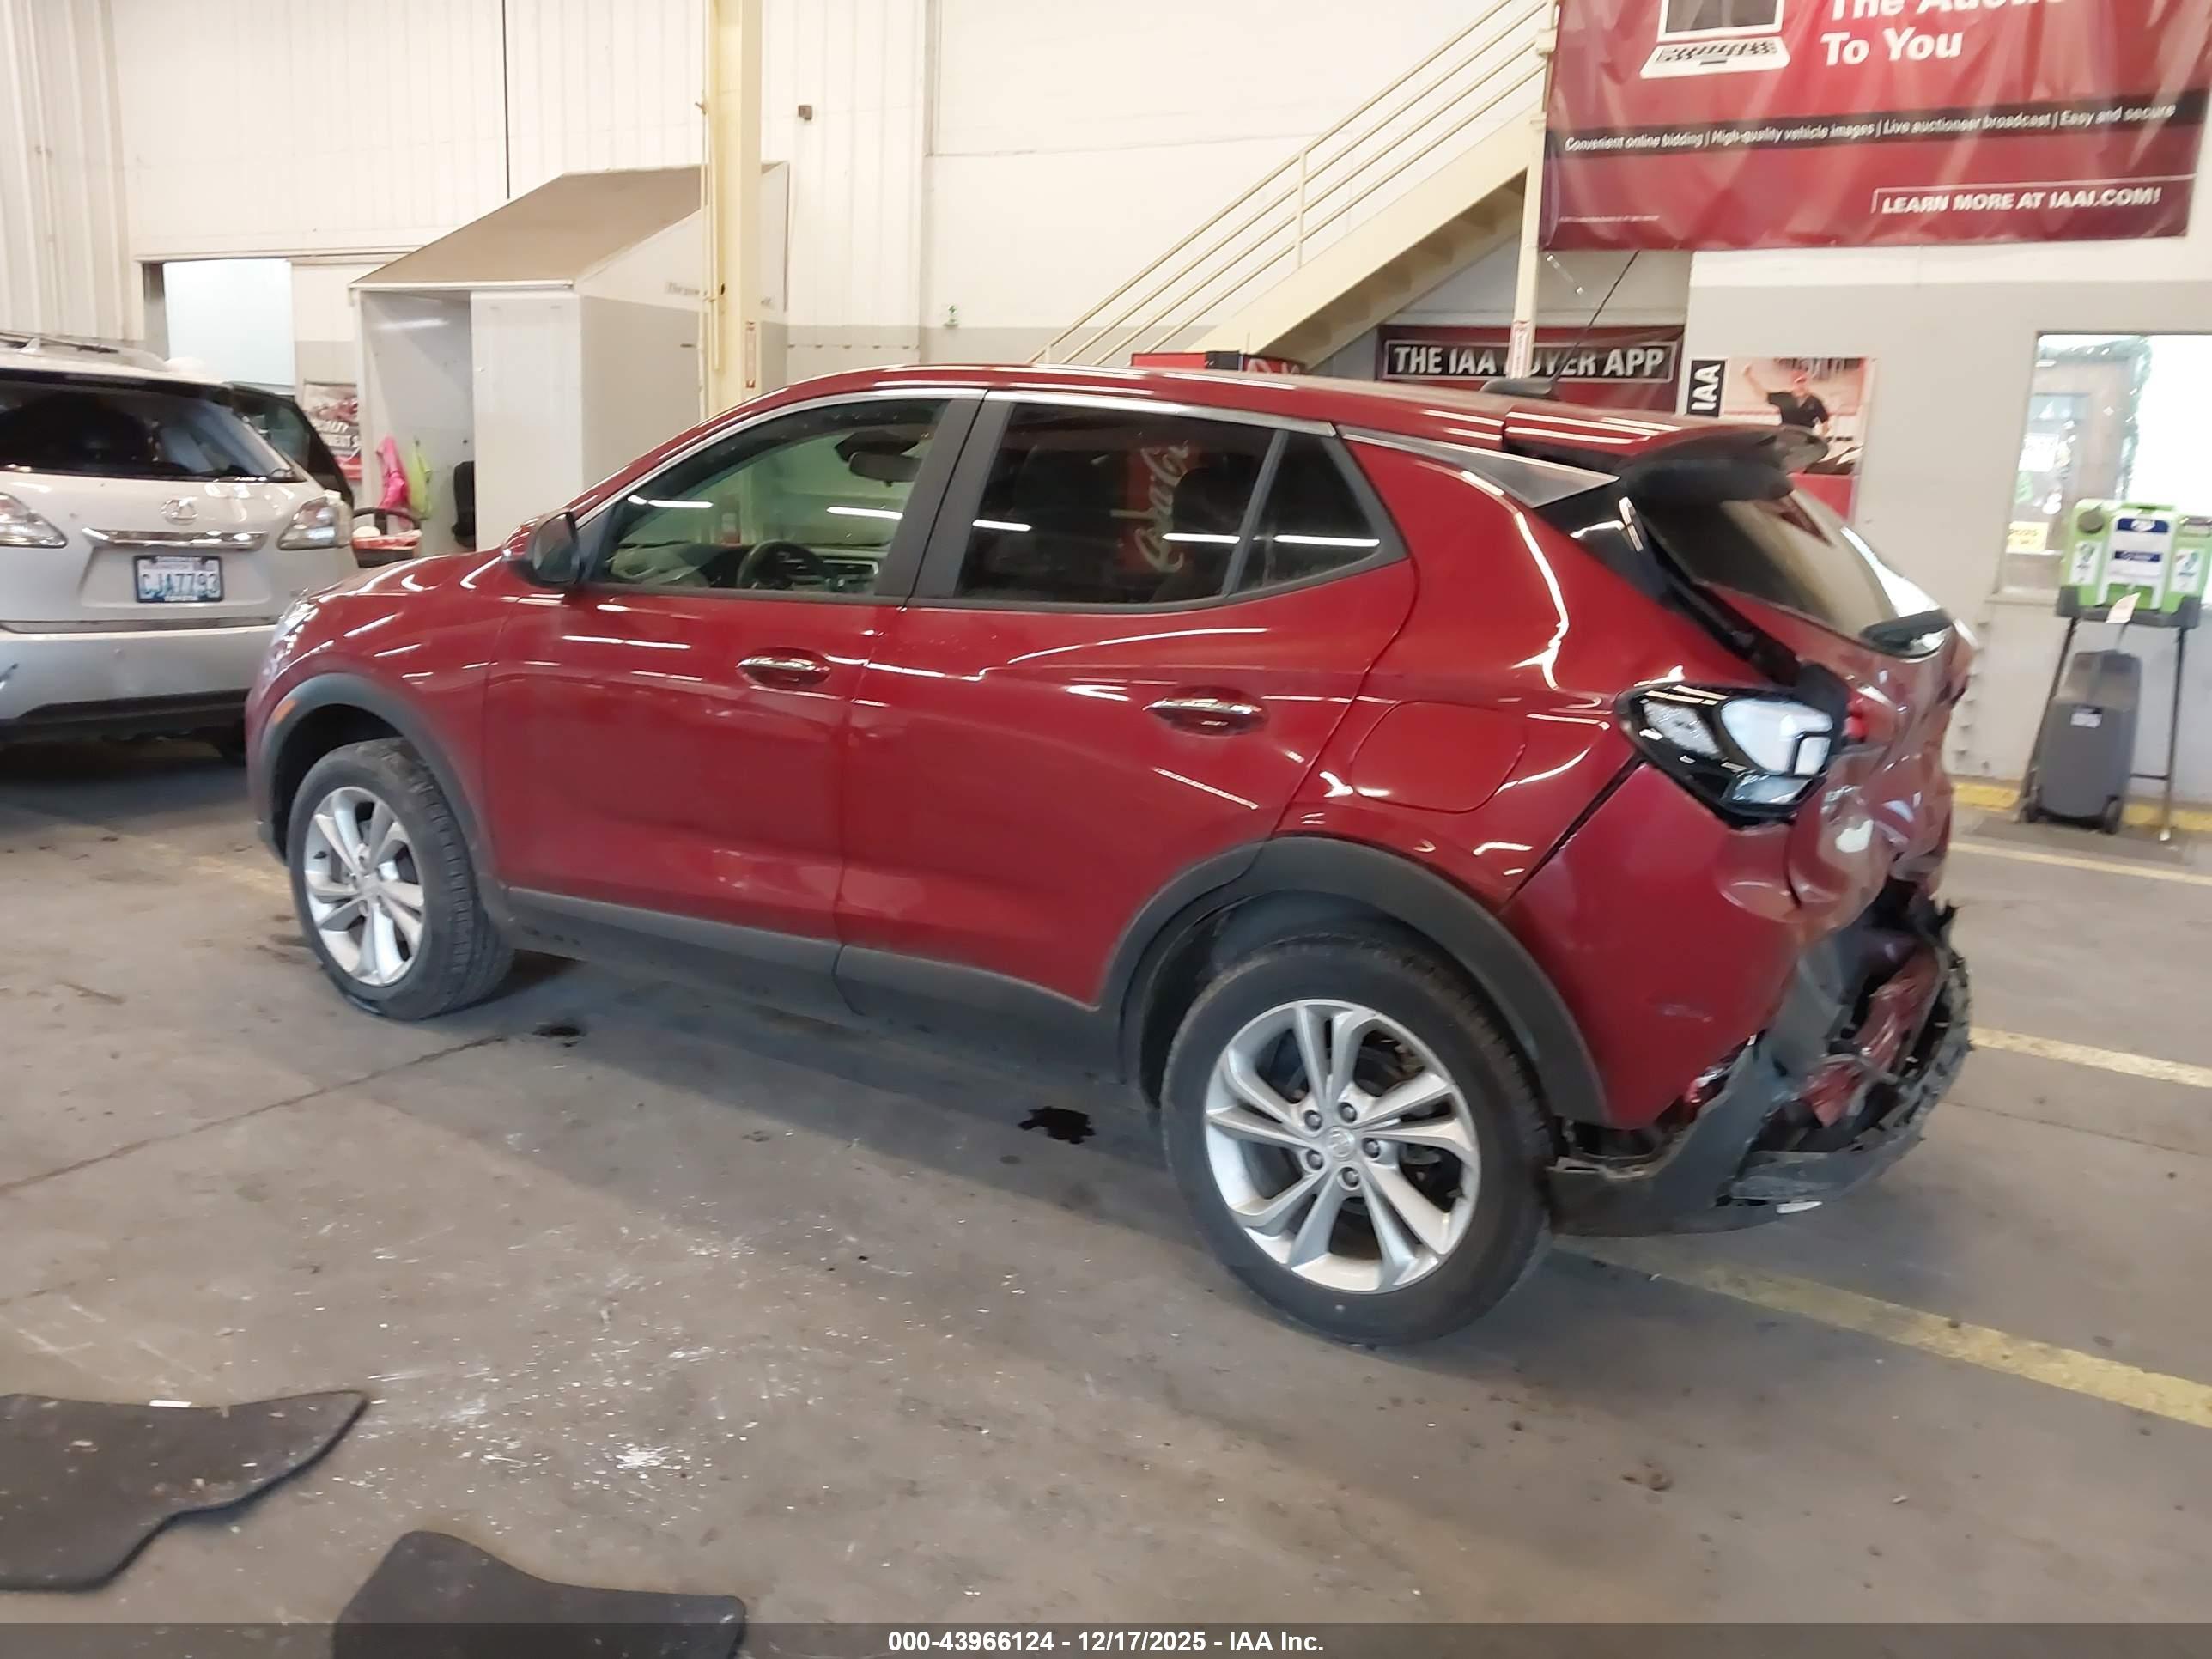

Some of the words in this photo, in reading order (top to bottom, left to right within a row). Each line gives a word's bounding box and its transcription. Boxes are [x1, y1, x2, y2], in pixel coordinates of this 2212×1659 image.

[1820, 32, 1869, 66] To
[1882, 27, 1964, 61] You
[1565, 137, 1624, 151] Convenient
[1625, 134, 1661, 149] online
[1662, 132, 1703, 149] bidding
[1712, 127, 1781, 145] High-quality
[1784, 125, 1828, 140] vehicle
[1830, 123, 1874, 140] images
[1882, 118, 1911, 134] Live
[1911, 117, 1980, 133] auctioneer
[1982, 112, 2051, 129] broadcast
[2059, 109, 2094, 127] Easy
[2095, 106, 2122, 121] and
[2123, 104, 2176, 120] secure
[1881, 193, 1949, 214] LEARN
[1953, 191, 2014, 211] MORE
[2015, 191, 2045, 210] AT
[2048, 186, 2162, 209] IAAI.COM!
[1394, 346, 1444, 374] THE
[1449, 348, 1497, 375] IAA
[1504, 349, 1597, 376] UYER
[1602, 347, 1664, 376] APP
[1691, 363, 1721, 410] IAA
